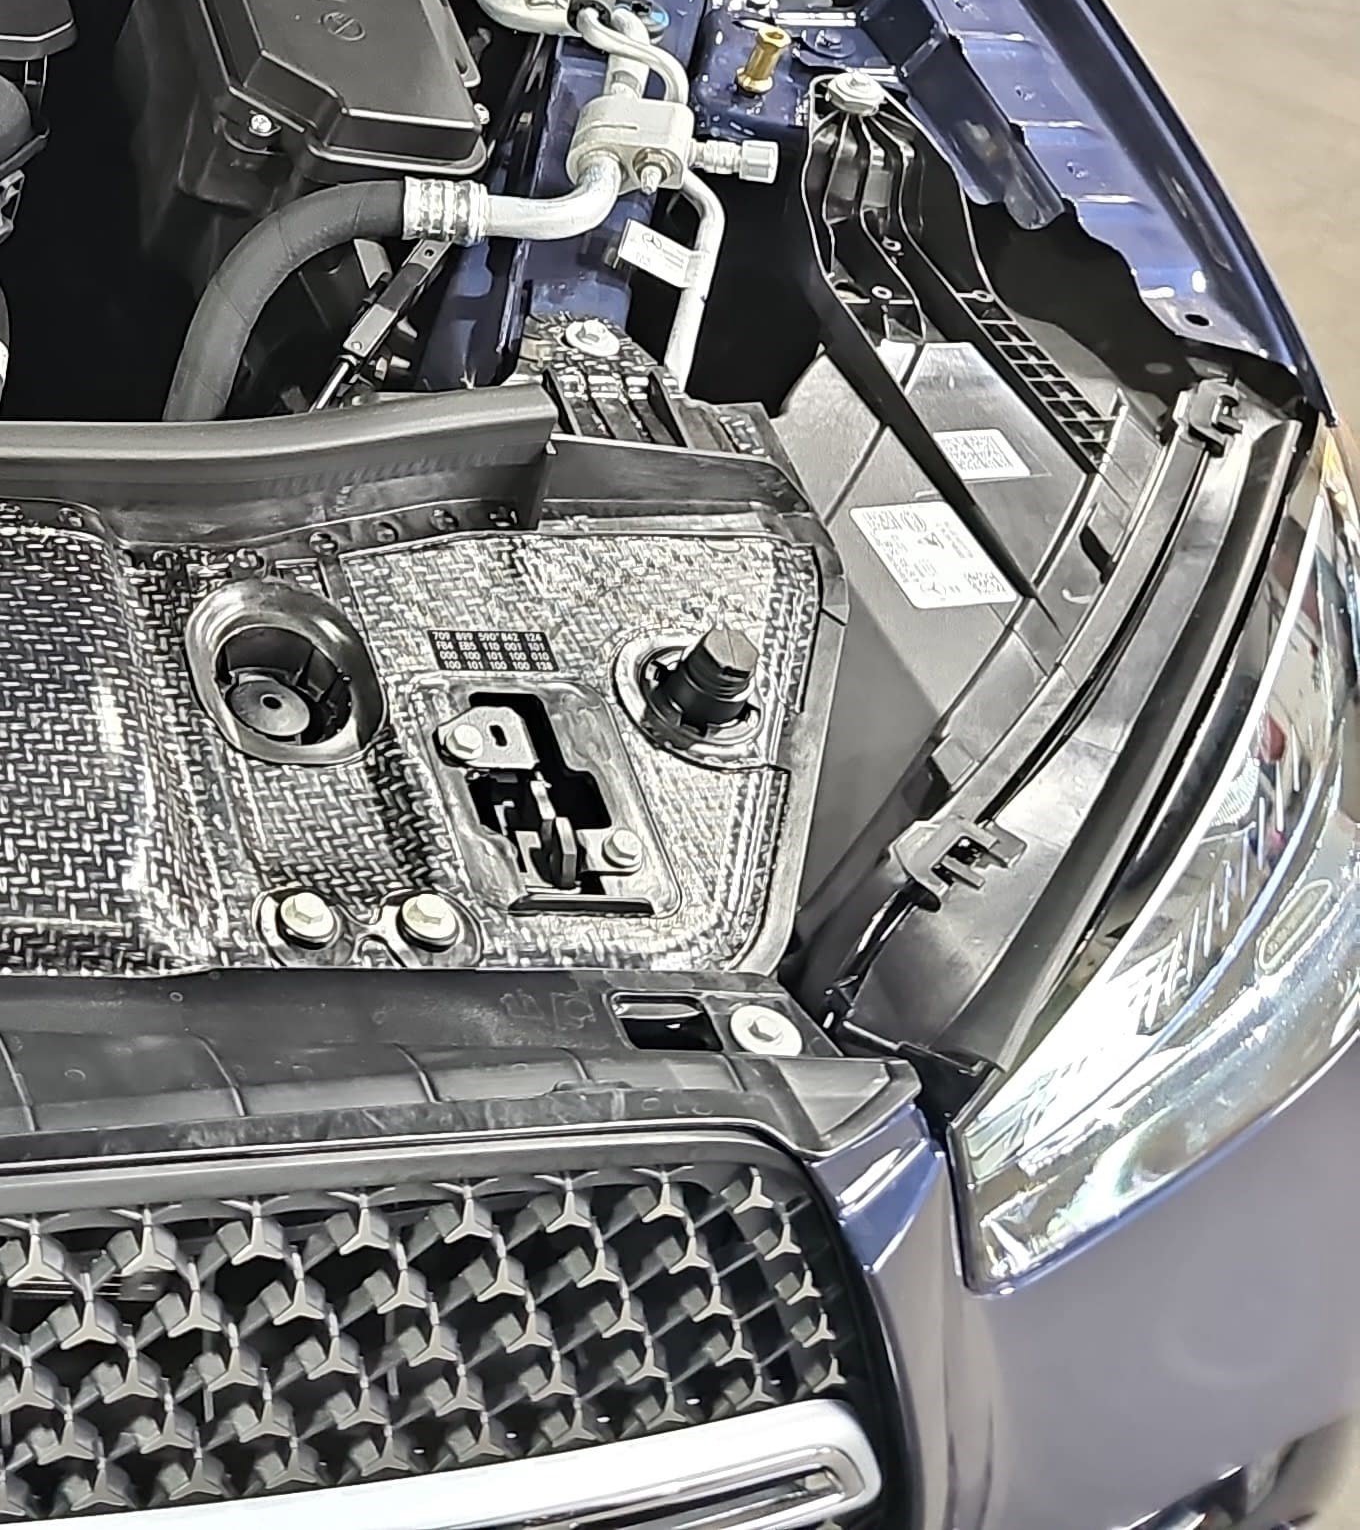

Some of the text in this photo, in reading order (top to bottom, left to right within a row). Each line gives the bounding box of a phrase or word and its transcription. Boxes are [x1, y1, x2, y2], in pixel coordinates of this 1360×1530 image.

[432, 631, 451, 640] 709
[482, 642, 500, 651] 110
[503, 643, 522, 651] 001
[527, 643, 545, 651] 101
[440, 651, 550, 661] 000 100 101 100 010
[444, 661, 461, 669] 100
[467, 661, 484, 670] 101
[489, 661, 508, 670] 100
[512, 662, 530, 670] 100
